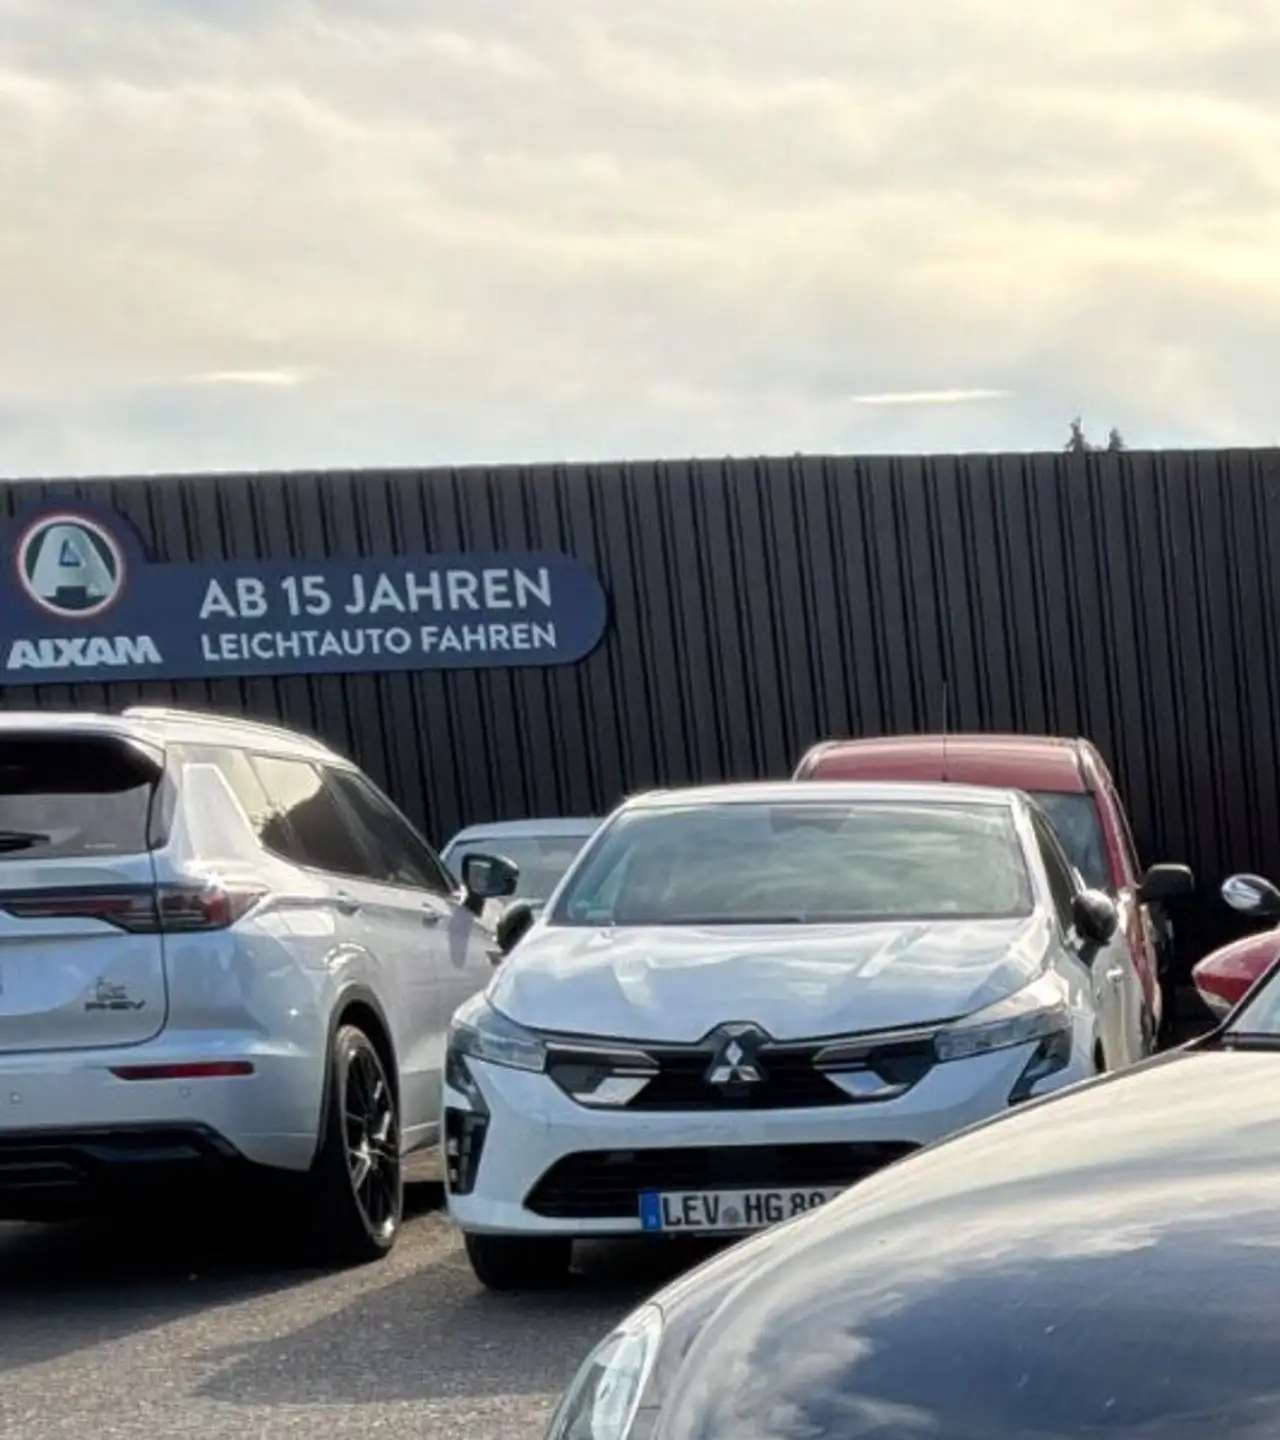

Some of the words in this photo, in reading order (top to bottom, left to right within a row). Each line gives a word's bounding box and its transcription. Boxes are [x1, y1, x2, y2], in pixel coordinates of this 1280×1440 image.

[199, 577, 268, 619] AB
[281, 575, 331, 616] 15
[344, 567, 551, 615] JAHREN
[6, 635, 163, 669] AIXAM
[201, 626, 411, 662] LEICHTAUTO
[421, 622, 556, 652] FAHREN
[662, 1194, 719, 1227] LEV
[744, 1192, 783, 1224] HG
